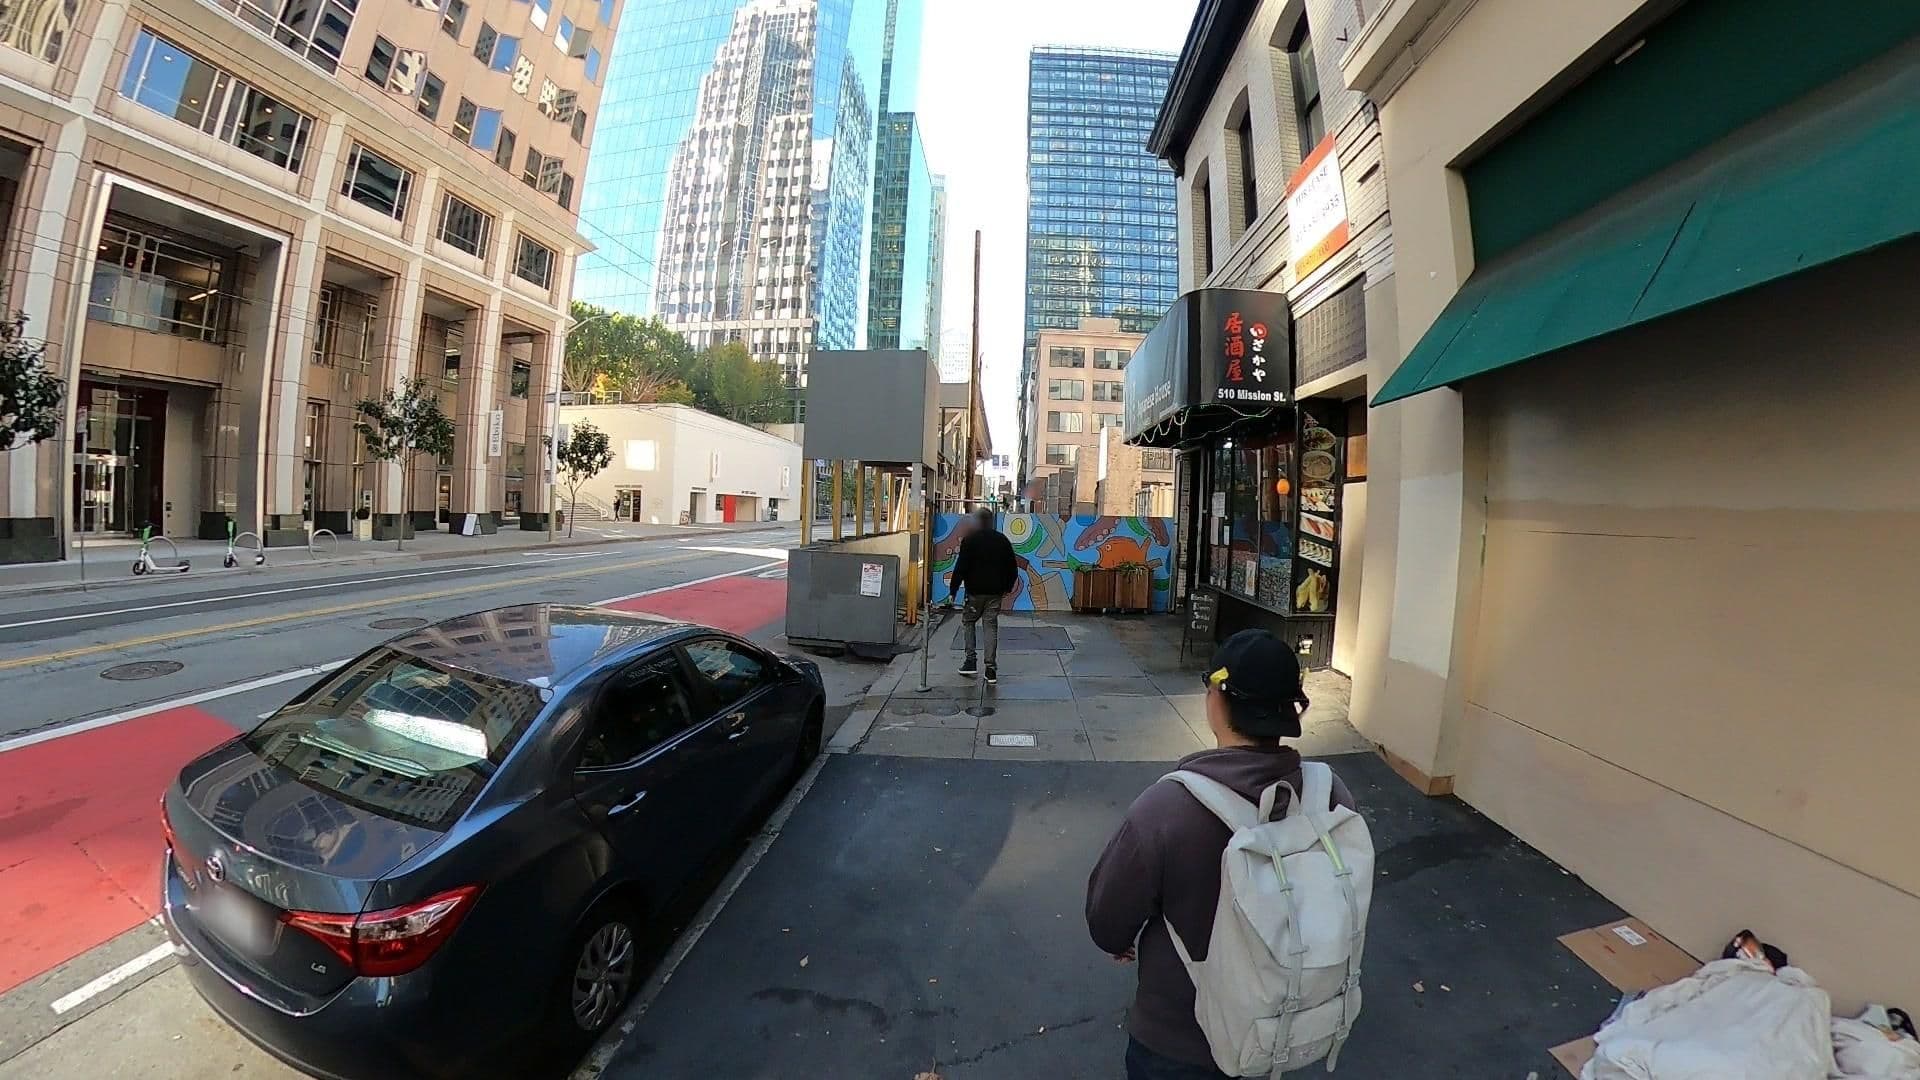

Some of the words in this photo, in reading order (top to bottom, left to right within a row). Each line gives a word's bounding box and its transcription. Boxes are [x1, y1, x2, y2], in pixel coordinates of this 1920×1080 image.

[1224, 312, 1244, 381] 居酒屋
[1218, 389, 1235, 399] 510
[1237, 389, 1272, 400] Mission
[1273, 391, 1286, 402] St.
